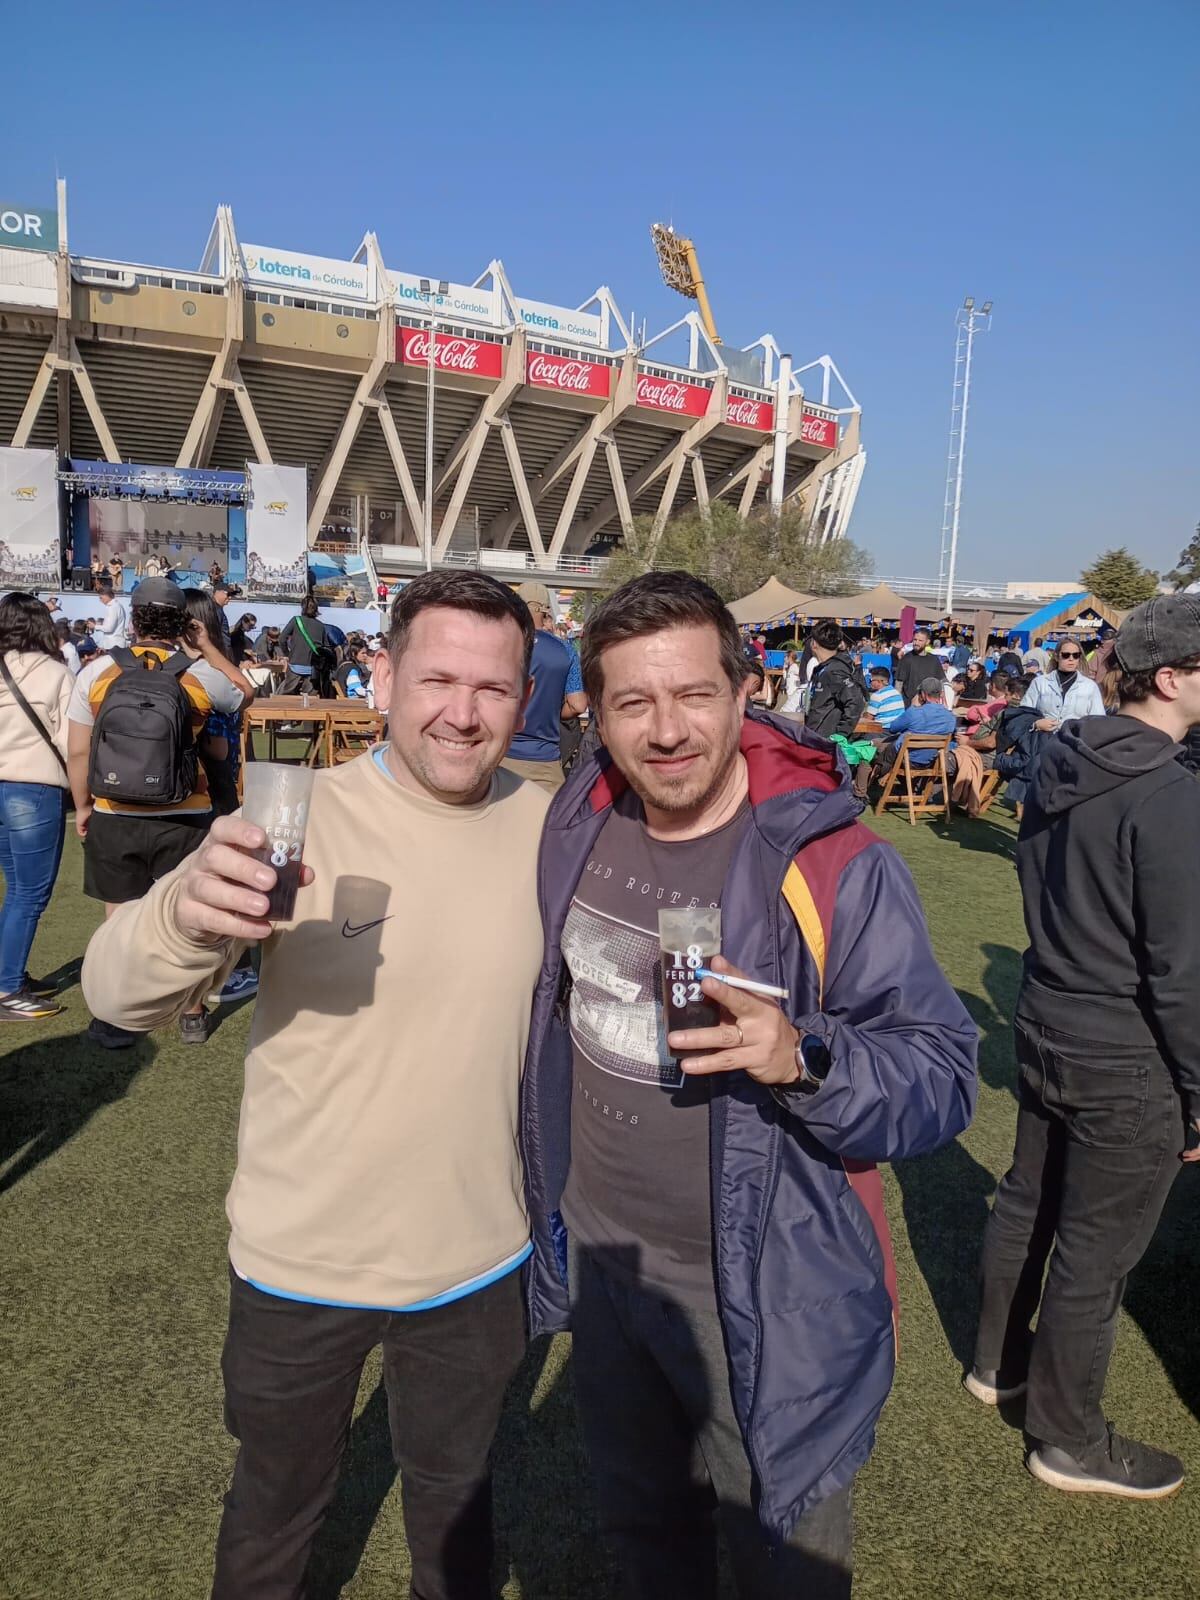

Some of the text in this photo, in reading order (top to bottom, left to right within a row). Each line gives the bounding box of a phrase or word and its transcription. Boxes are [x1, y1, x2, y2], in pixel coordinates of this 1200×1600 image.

[0, 211, 42, 238] OR
[323, 273, 363, 289] Córdoba
[265, 826, 299, 839] FERN
[270, 840, 302, 867] 82
[672, 944, 704, 969] 18
[571, 956, 612, 988] MOTEL
[665, 970, 695, 981] FERN
[671, 982, 705, 1009] 82
